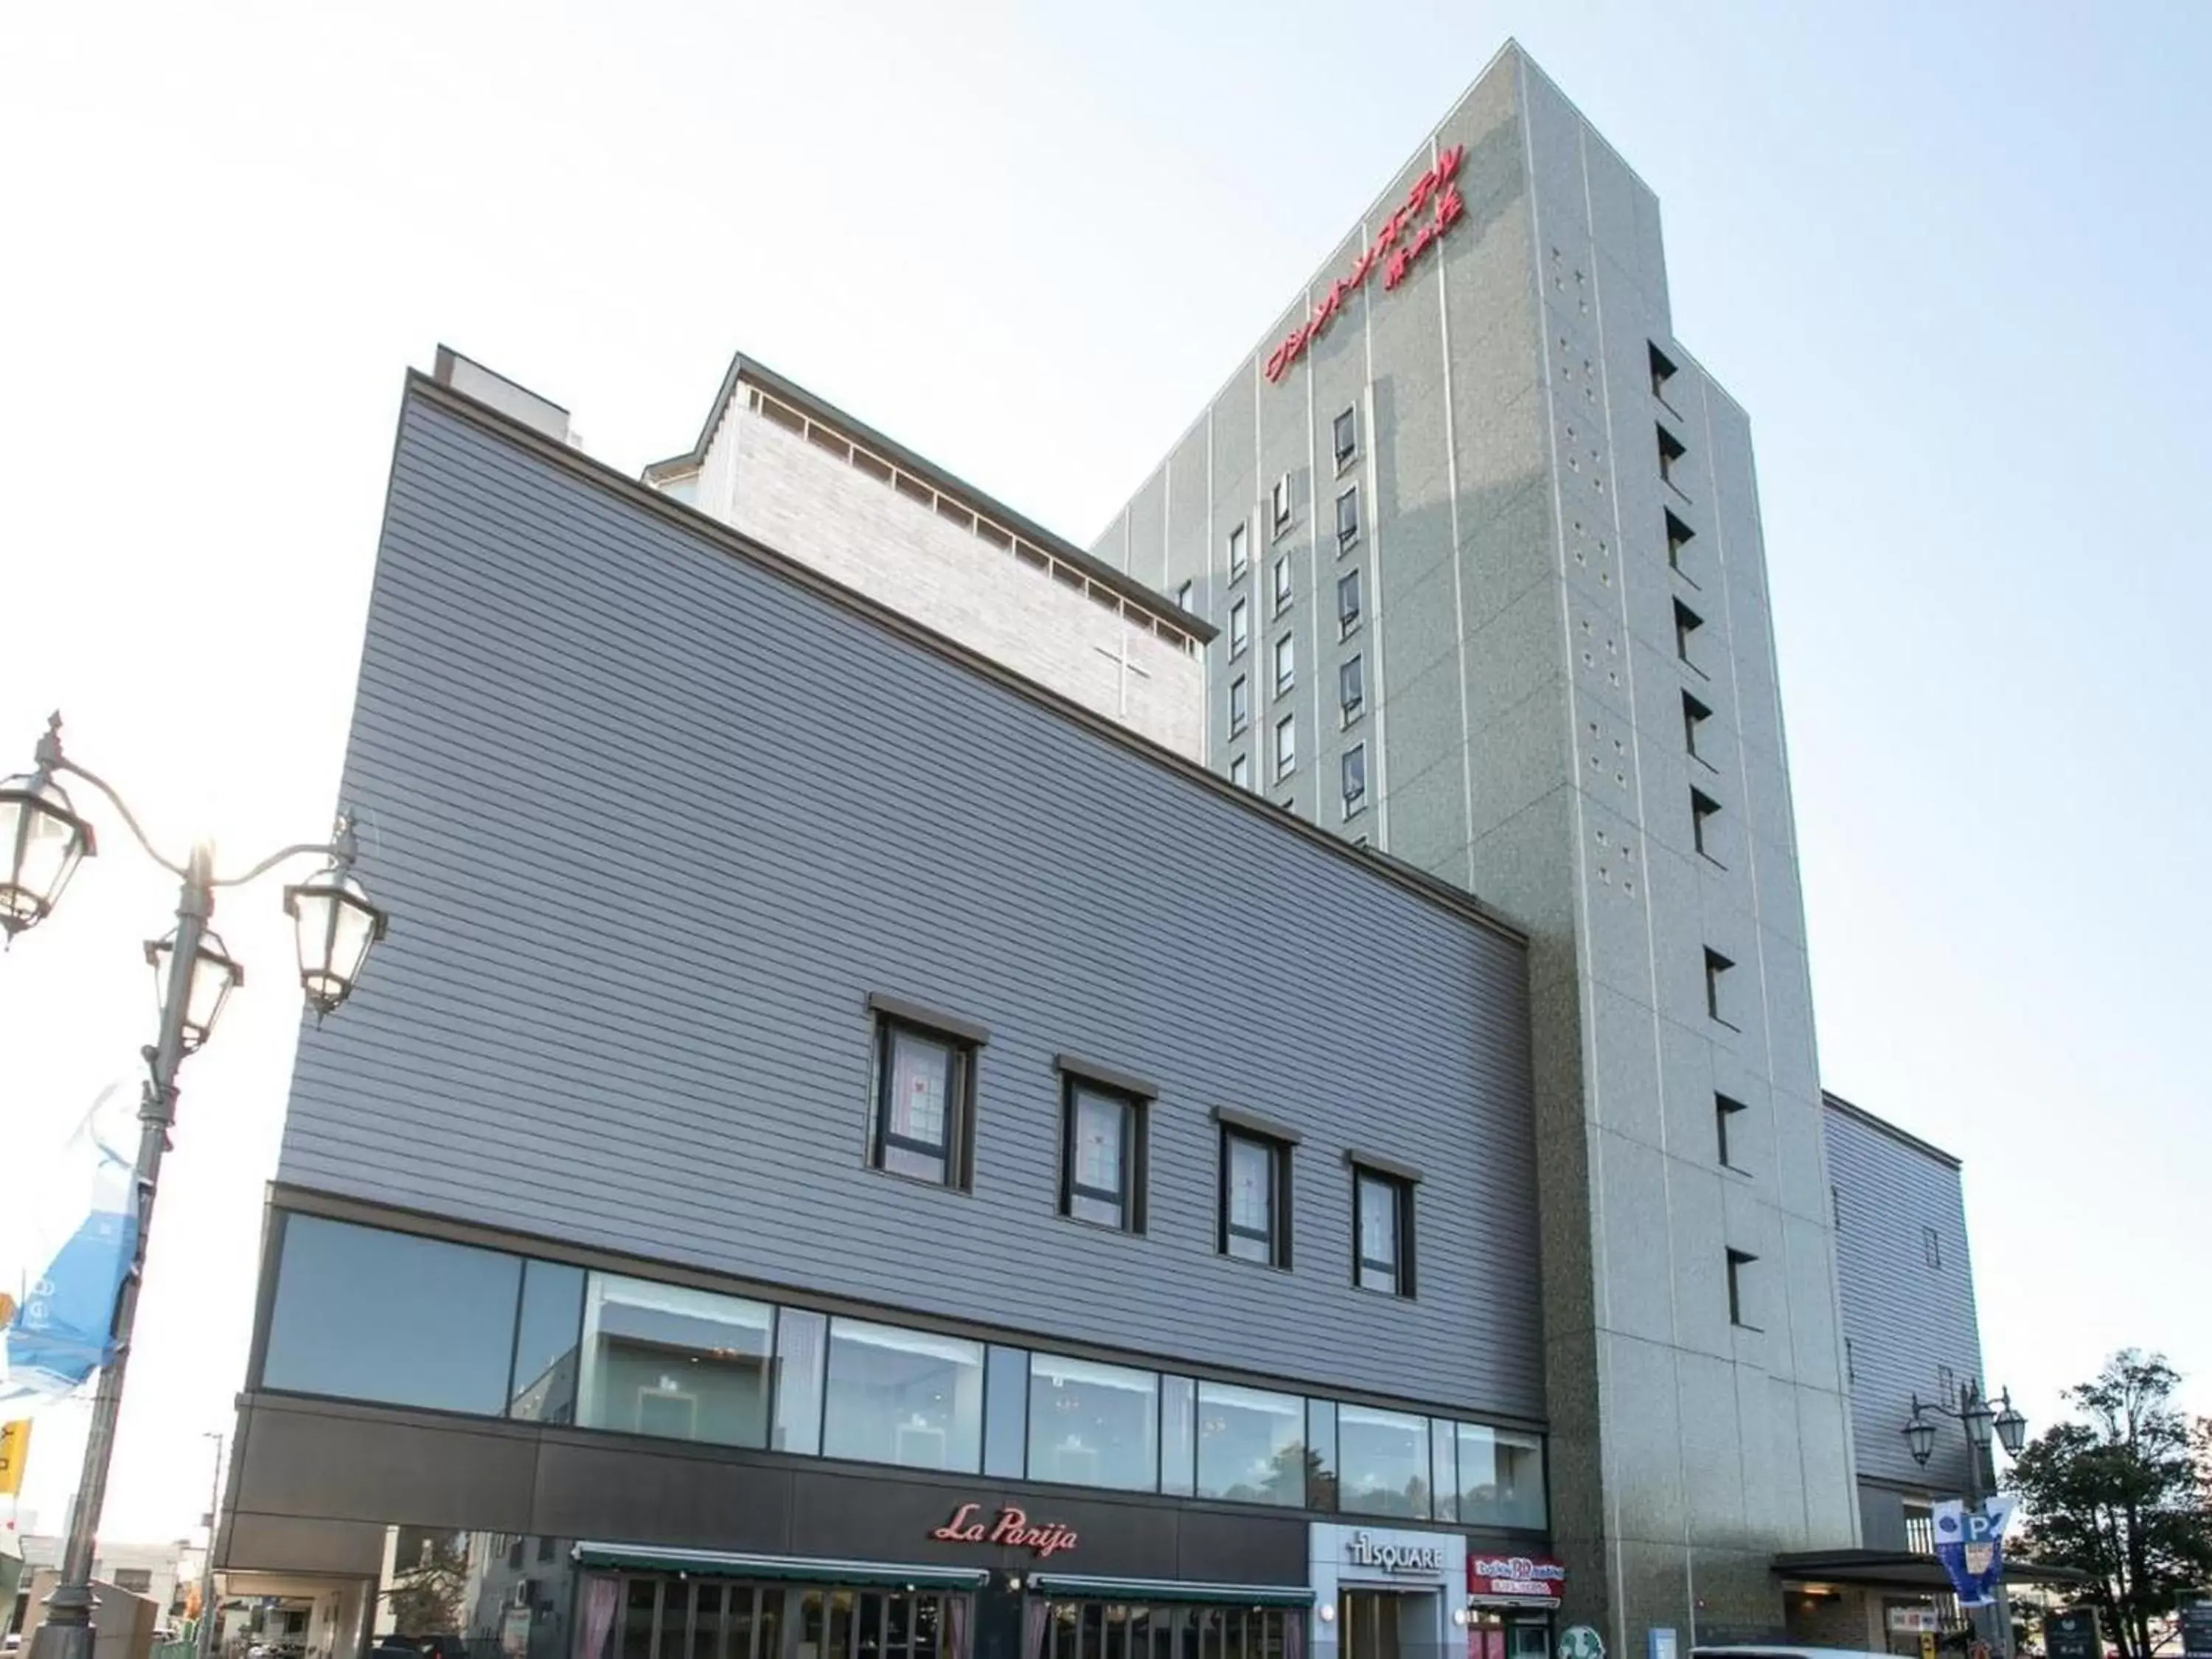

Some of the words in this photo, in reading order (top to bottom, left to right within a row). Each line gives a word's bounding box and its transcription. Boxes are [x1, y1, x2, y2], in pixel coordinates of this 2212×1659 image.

[1265, 145, 1464, 383] ワシントンホテル
[934, 1503, 985, 1540] La
[991, 1507, 1077, 1557] Parija
